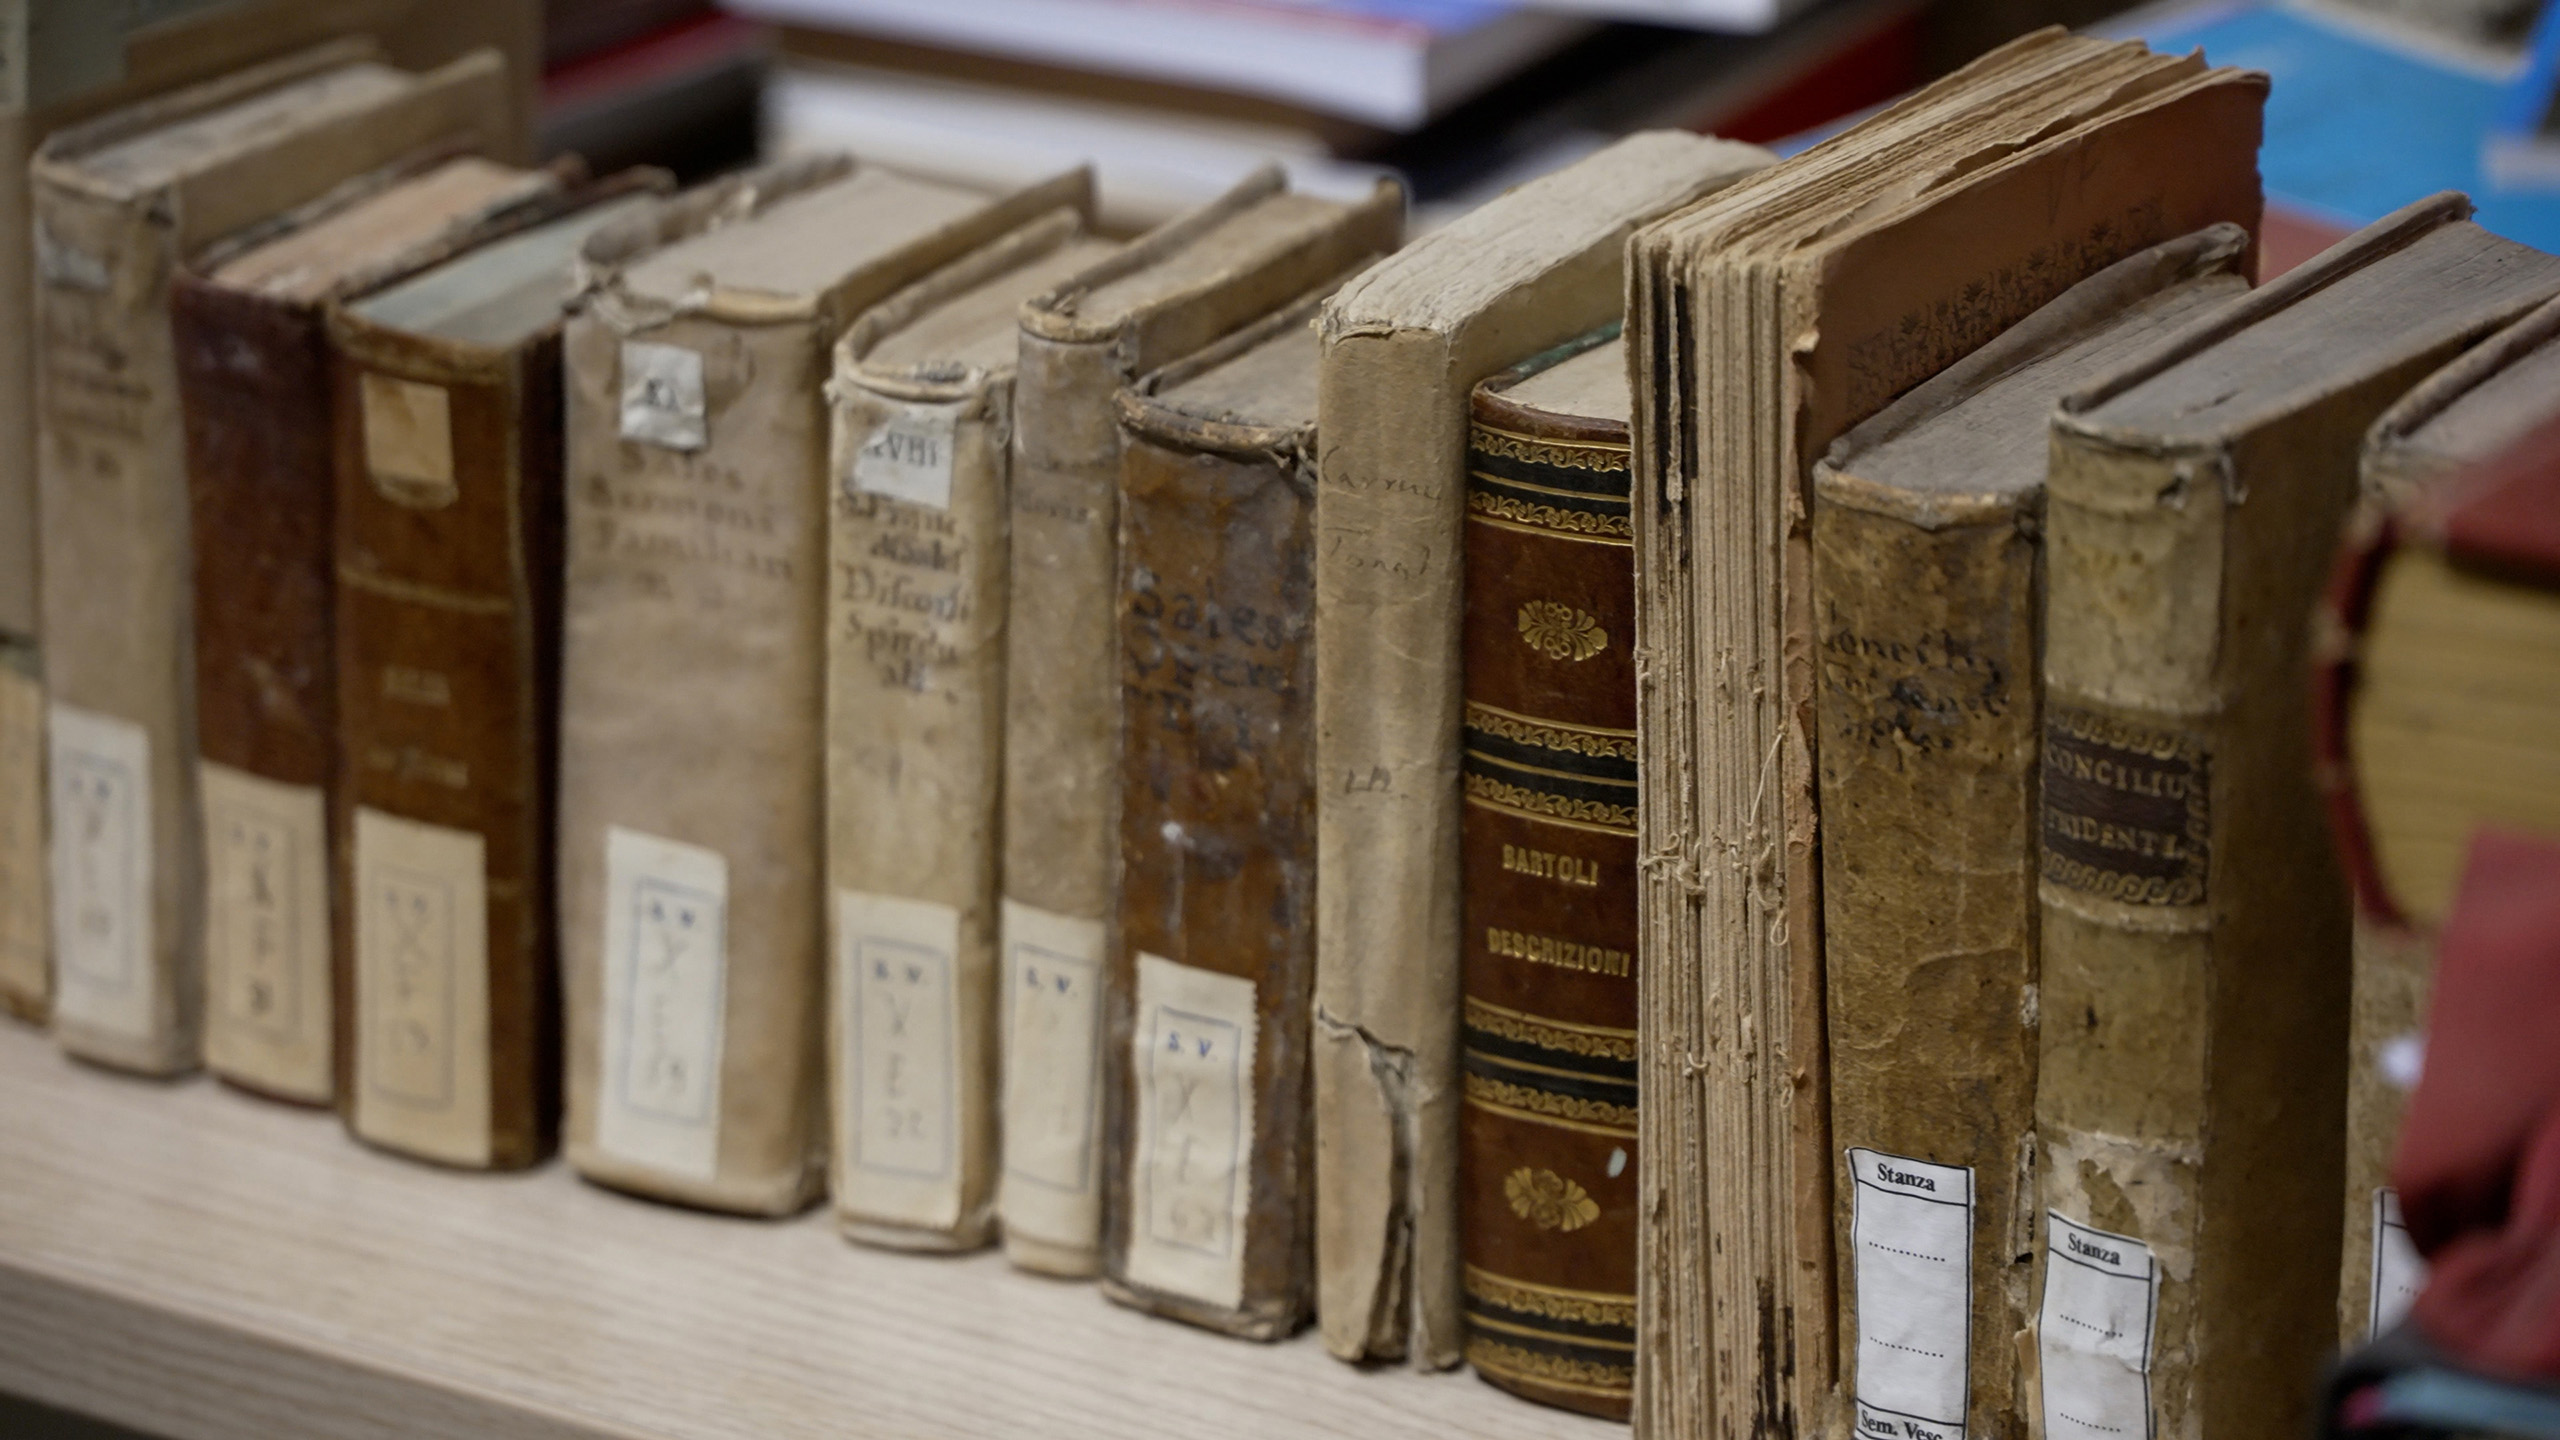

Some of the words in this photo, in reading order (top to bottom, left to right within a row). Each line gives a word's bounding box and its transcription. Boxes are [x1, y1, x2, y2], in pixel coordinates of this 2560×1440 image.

[1502, 843, 1599, 887] BARTOLI
[1488, 926, 1631, 978] DESCRIZIONI
[1877, 1163, 1936, 1193] Stanza
[2068, 1232, 2121, 1266] Stanza
[1861, 1409, 1899, 1437] Sem.
